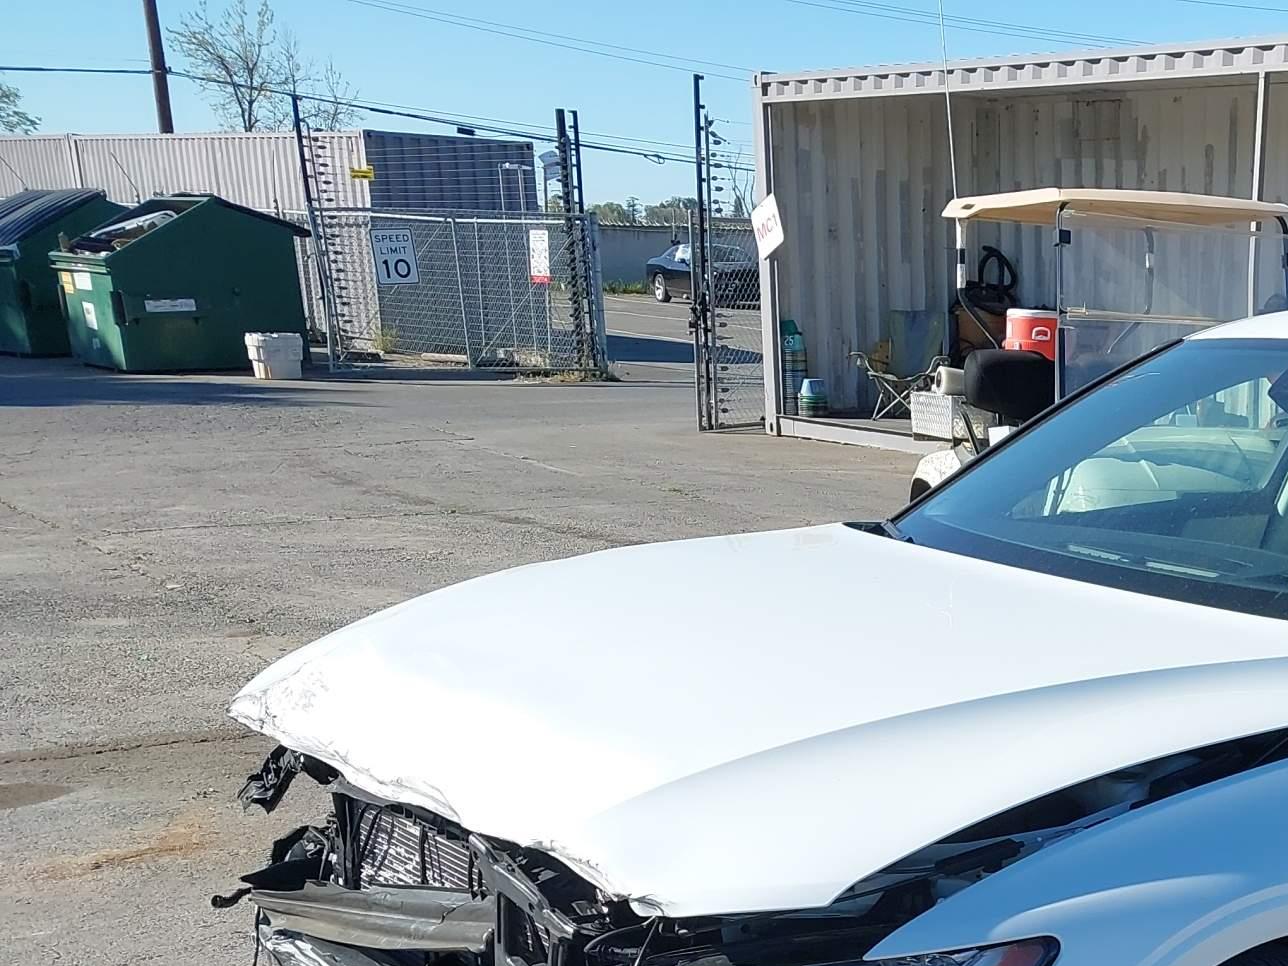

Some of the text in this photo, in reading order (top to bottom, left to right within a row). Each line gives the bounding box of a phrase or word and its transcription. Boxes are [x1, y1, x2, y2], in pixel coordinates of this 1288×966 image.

[757, 213, 778, 242] MC1
[374, 234, 410, 243] SPEED
[380, 246, 407, 255] LIMIT
[382, 258, 412, 279] 10
